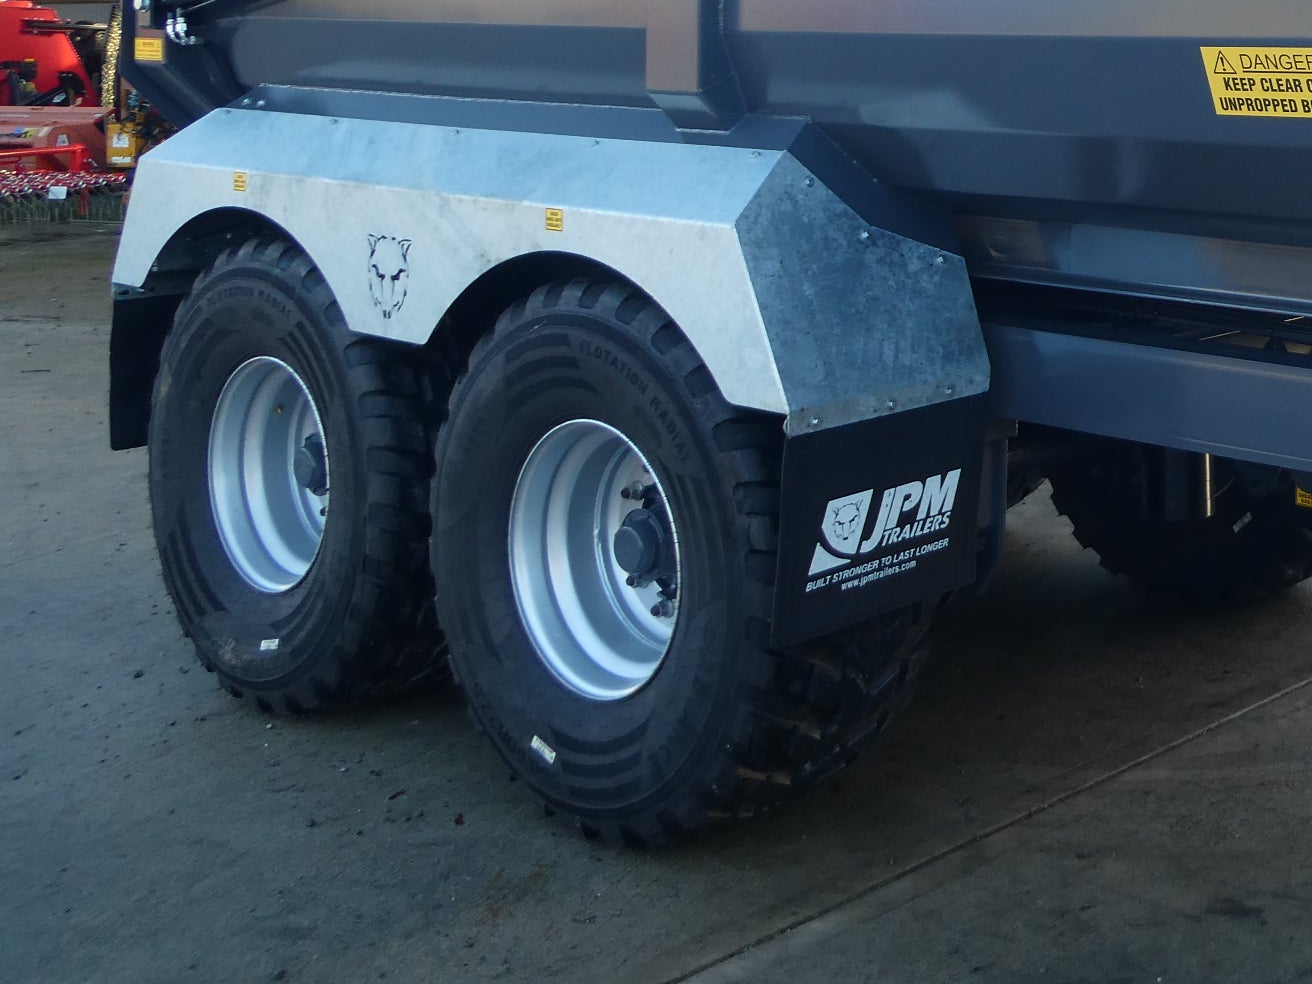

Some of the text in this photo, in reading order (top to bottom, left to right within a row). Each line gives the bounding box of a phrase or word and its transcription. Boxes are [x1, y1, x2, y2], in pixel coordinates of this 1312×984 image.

[1222, 77, 1256, 92] KEEP
[1260, 77, 1304, 93] CLEAR
[1219, 97, 1298, 113] UNPROPPED
[580, 339, 649, 394] FLOTATION
[859, 468, 962, 553] JPM
[881, 511, 952, 546] TRAILERS
[805, 538, 950, 592] BUILT STRONGER TO LAST LONGER
[841, 560, 917, 591] www.jpmtrailers.com
